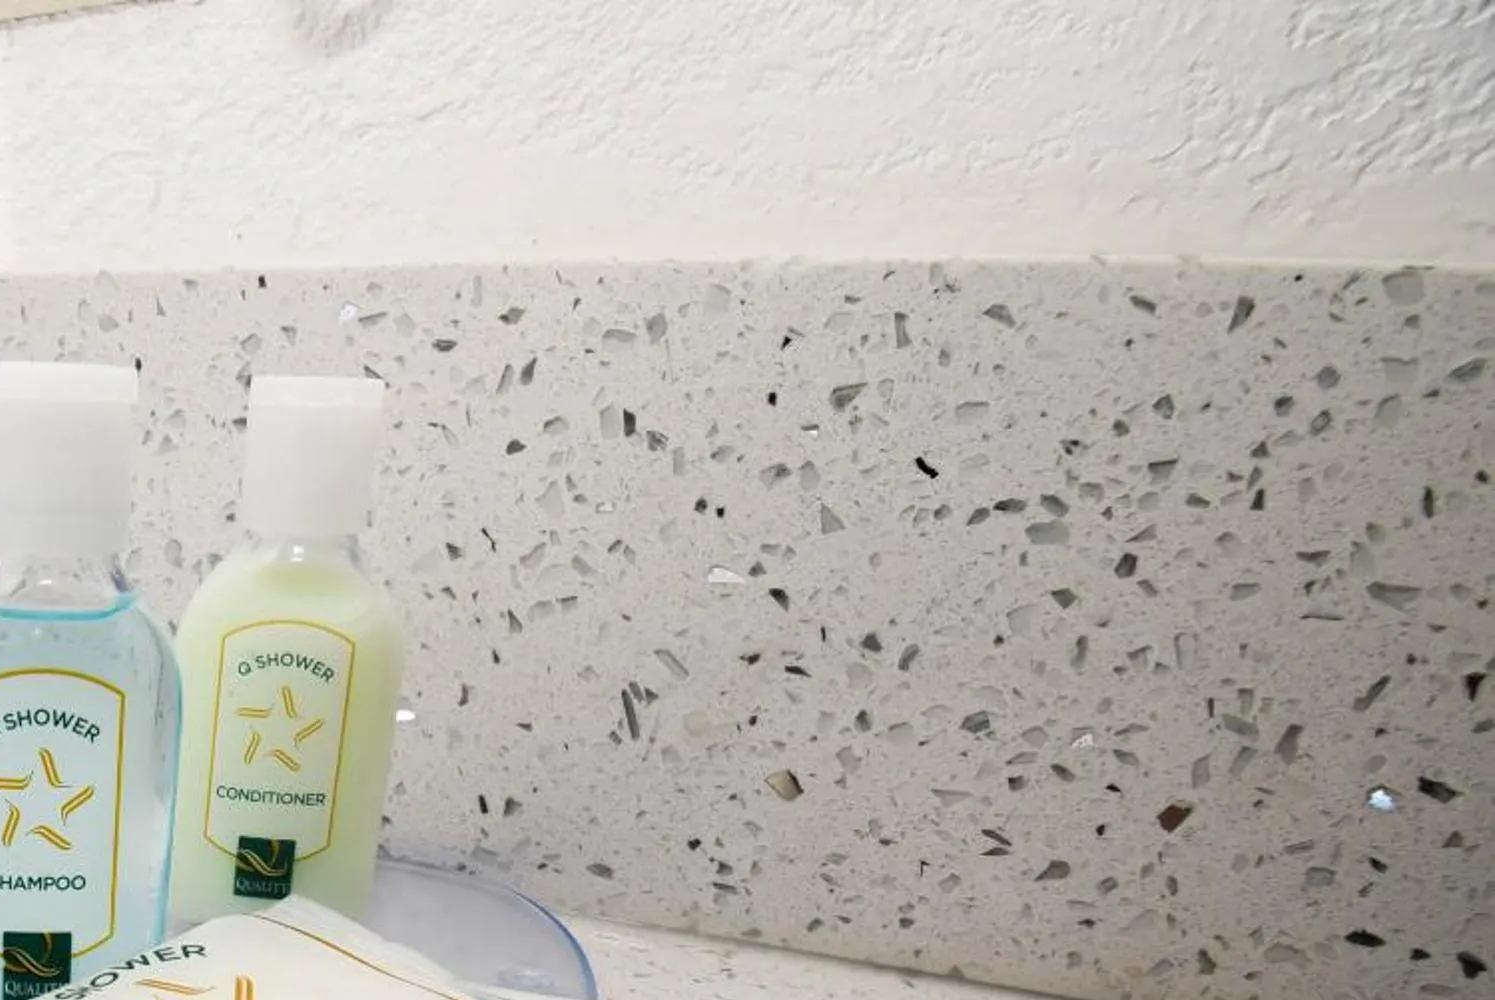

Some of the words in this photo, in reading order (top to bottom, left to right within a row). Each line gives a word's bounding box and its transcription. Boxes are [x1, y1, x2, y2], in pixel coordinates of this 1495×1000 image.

[238, 661, 252, 677] Q
[255, 652, 335, 683] SHOWER
[3, 709, 101, 743] SHOWER
[216, 785, 326, 807] CONDITIONER
[5, 980, 65, 997] QUALIT
